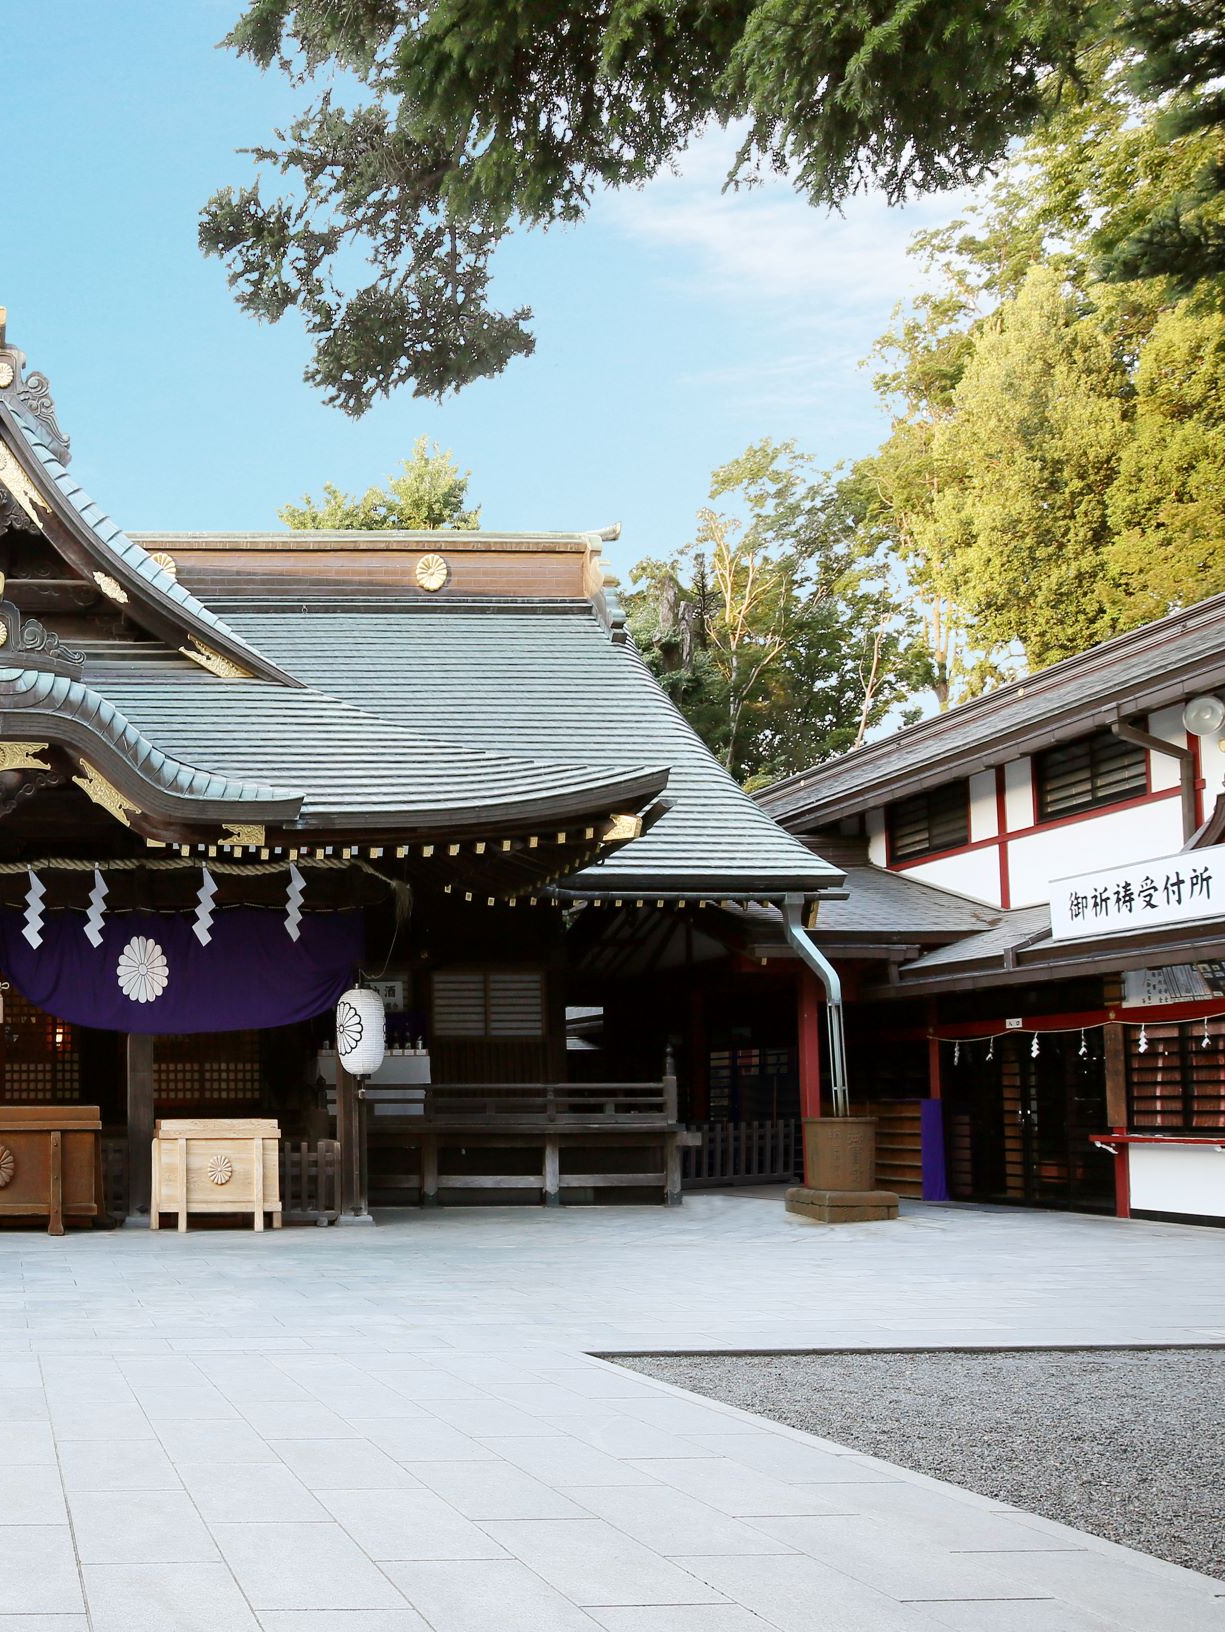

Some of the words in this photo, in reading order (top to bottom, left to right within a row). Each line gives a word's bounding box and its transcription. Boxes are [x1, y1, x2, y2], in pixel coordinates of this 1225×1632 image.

[1068, 865, 1213, 921] 御祈祷受付所
